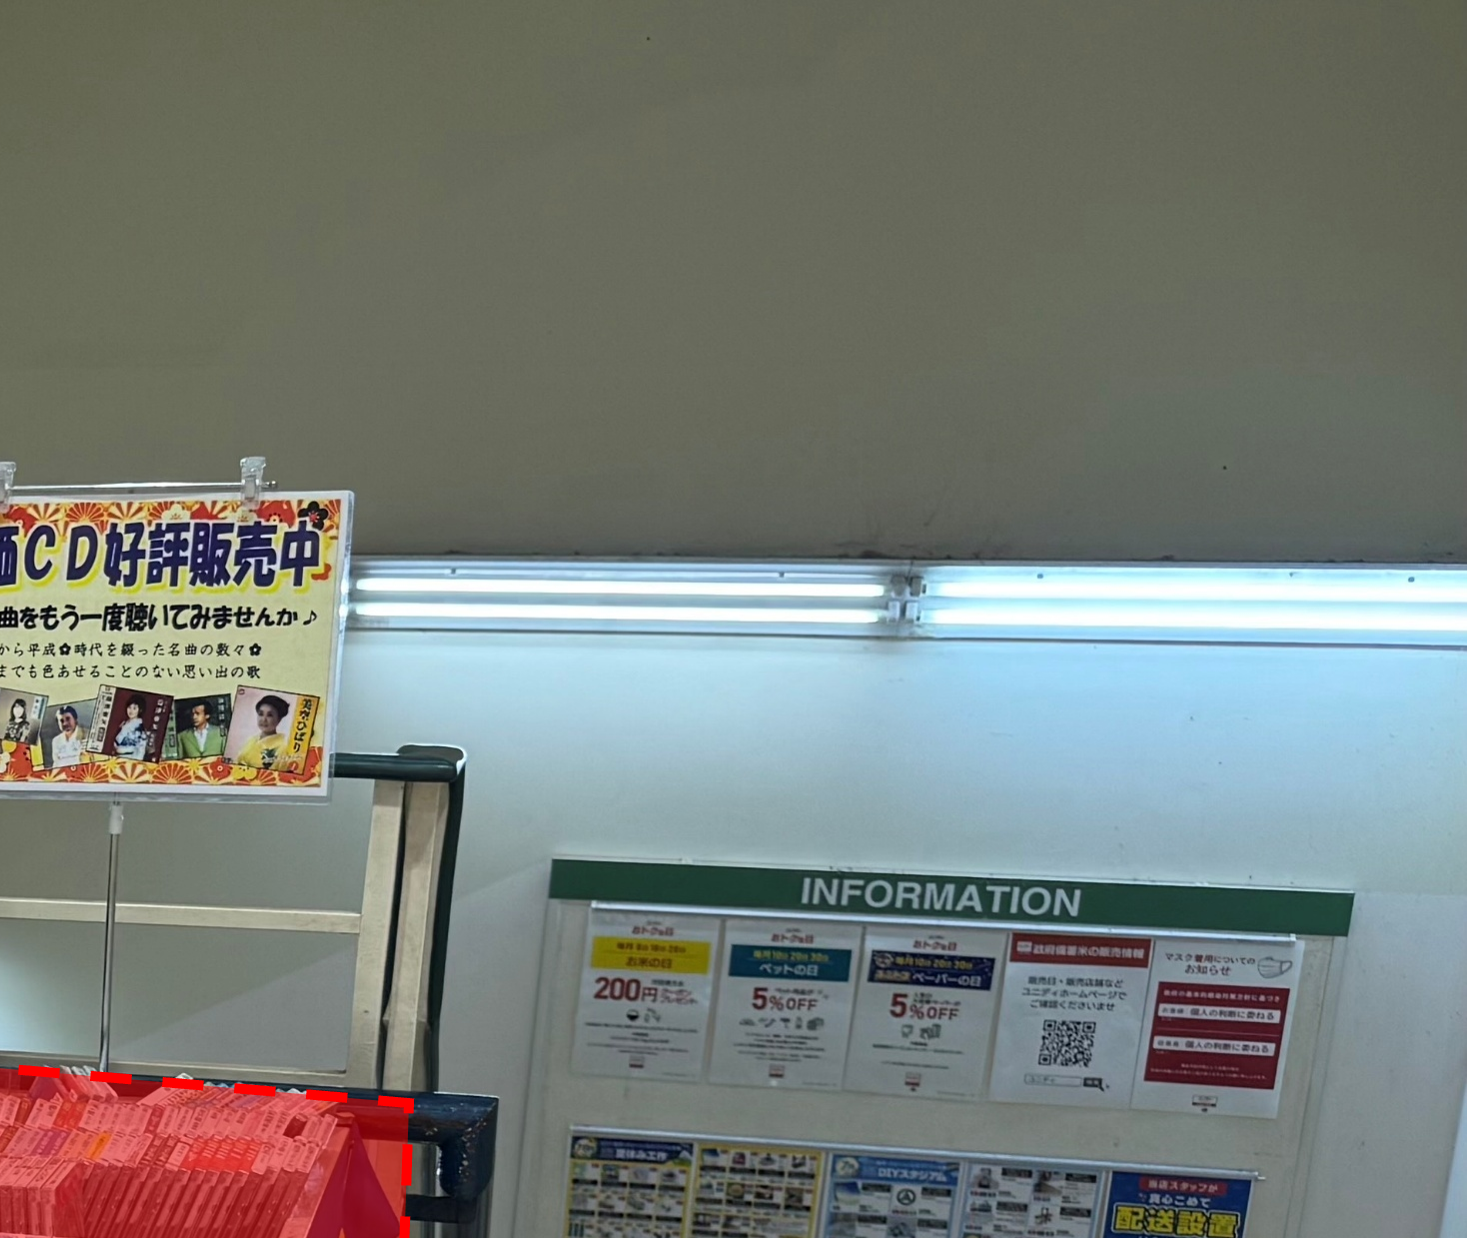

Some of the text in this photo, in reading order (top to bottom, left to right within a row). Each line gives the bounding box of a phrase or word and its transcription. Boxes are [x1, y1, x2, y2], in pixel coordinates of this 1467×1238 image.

[291, 698, 313, 753] 美空ひばり
[800, 876, 1083, 919] INFORMATION
[1165, 952, 1256, 966] マスク着用についての
[1184, 964, 1232, 977] お知らせ
[593, 977, 659, 1003] 200円
[751, 986, 820, 1012] 5%OFF
[889, 992, 960, 1021] 5%OFF
[1114, 1205, 1239, 1238] 配送設置
